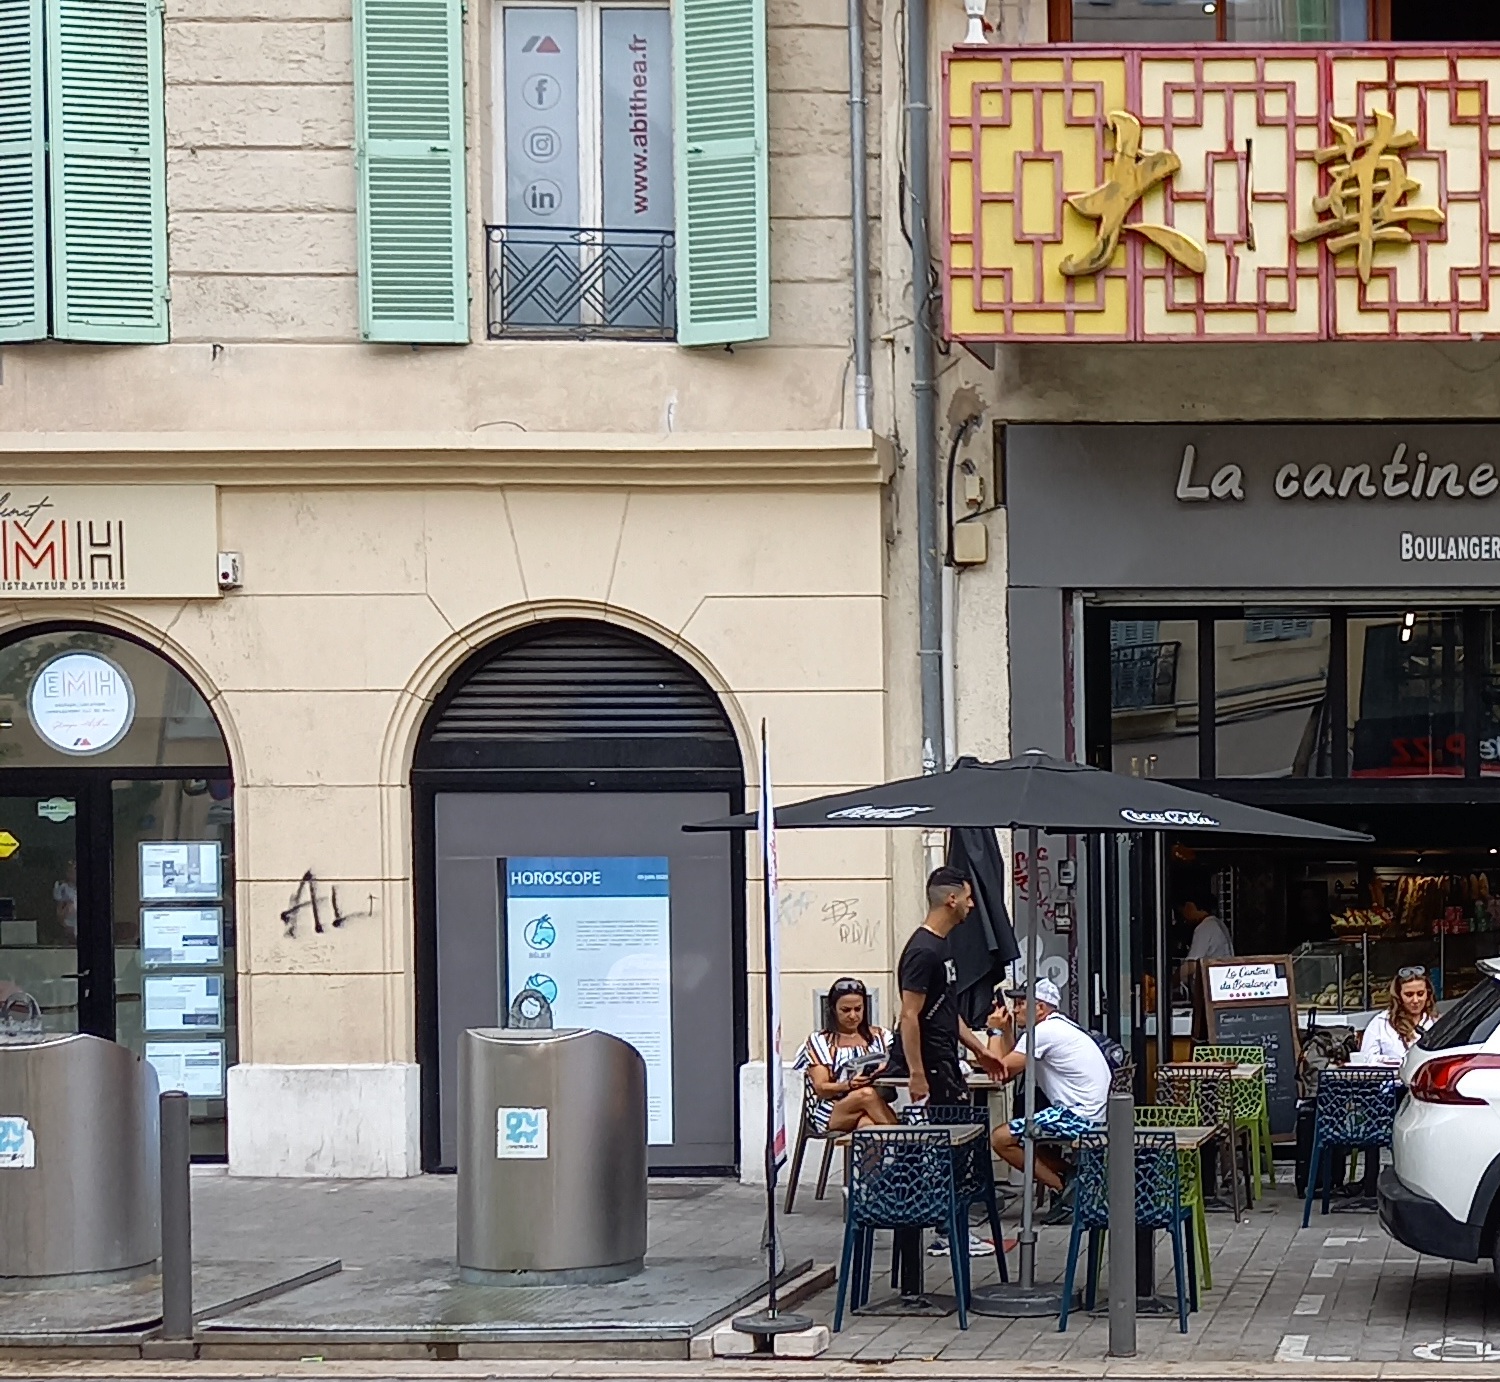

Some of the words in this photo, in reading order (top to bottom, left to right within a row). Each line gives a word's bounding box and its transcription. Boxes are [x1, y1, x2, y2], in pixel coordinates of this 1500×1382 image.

[628, 34, 648, 214] www.abithea.fr
[531, 185, 554, 208] in
[1177, 444, 1245, 500] La
[1274, 443, 1499, 498] cantine
[0, 581, 66, 591] ISTRATEUR
[72, 581, 86, 591] DE
[44, 671, 117, 698] EMH
[1121, 809, 1220, 826] Coca-Cola
[511, 871, 601, 885] HOROSCOPE
[1225, 968, 1237, 979] La
